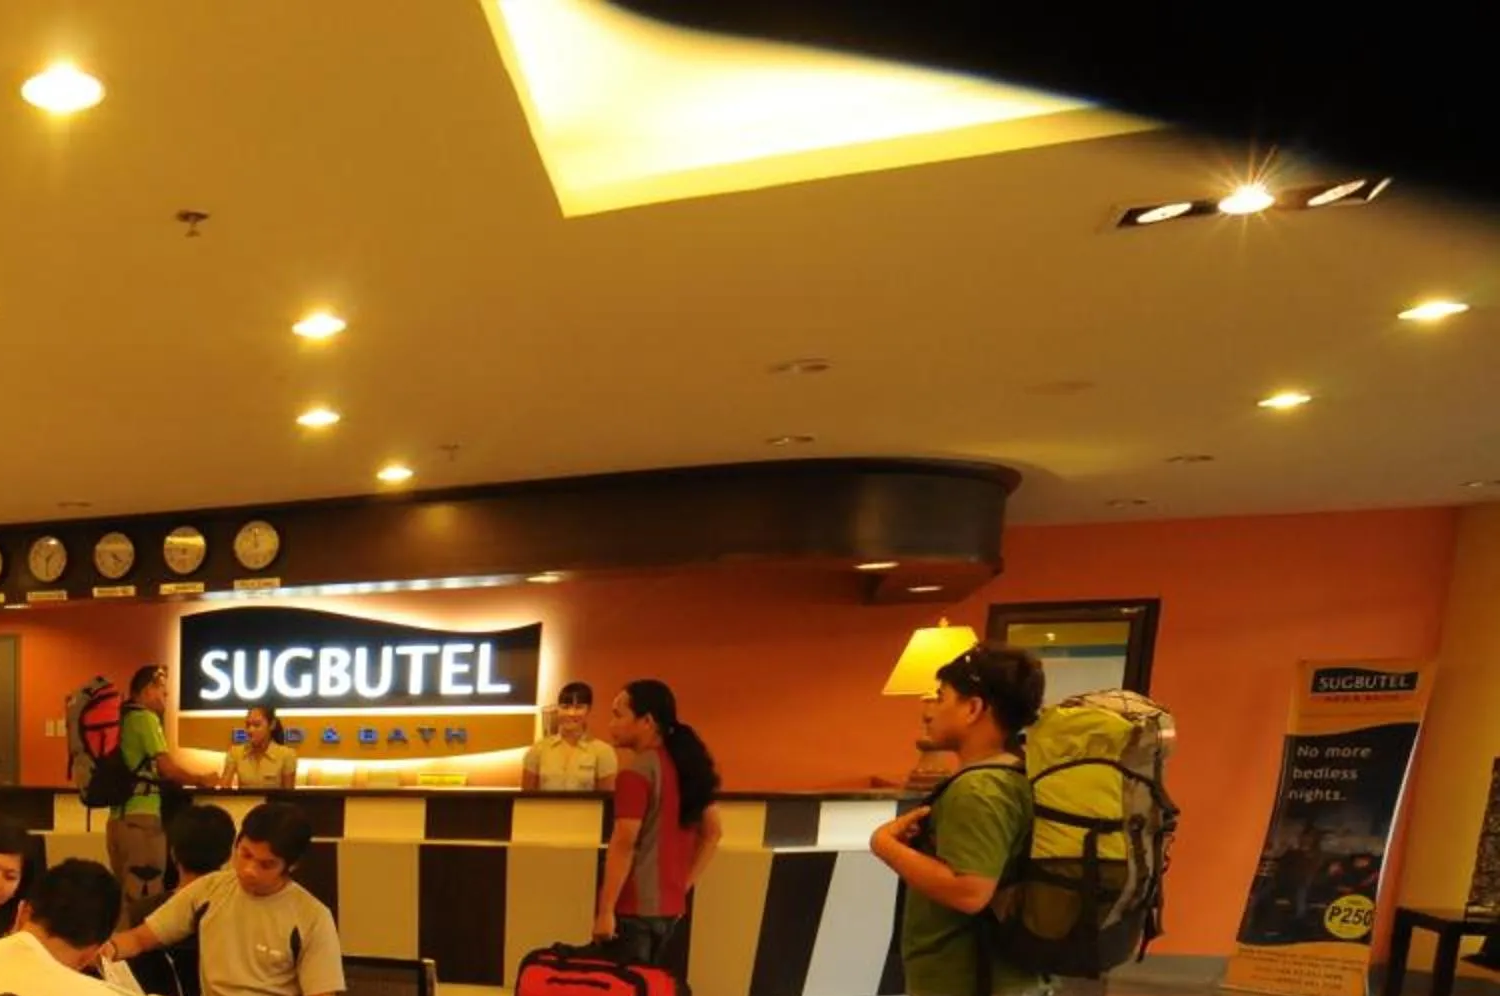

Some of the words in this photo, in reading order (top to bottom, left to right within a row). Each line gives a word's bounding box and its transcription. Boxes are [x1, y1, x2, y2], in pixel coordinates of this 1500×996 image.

[199, 641, 511, 701] SUGBUTEL
[1318, 673, 1411, 691] SUGBUTEL
[232, 727, 305, 745] BD
[357, 726, 469, 746] BATH
[1296, 744, 1320, 759] No
[1324, 746, 1373, 759] more
[1292, 766, 1359, 781] bedless
